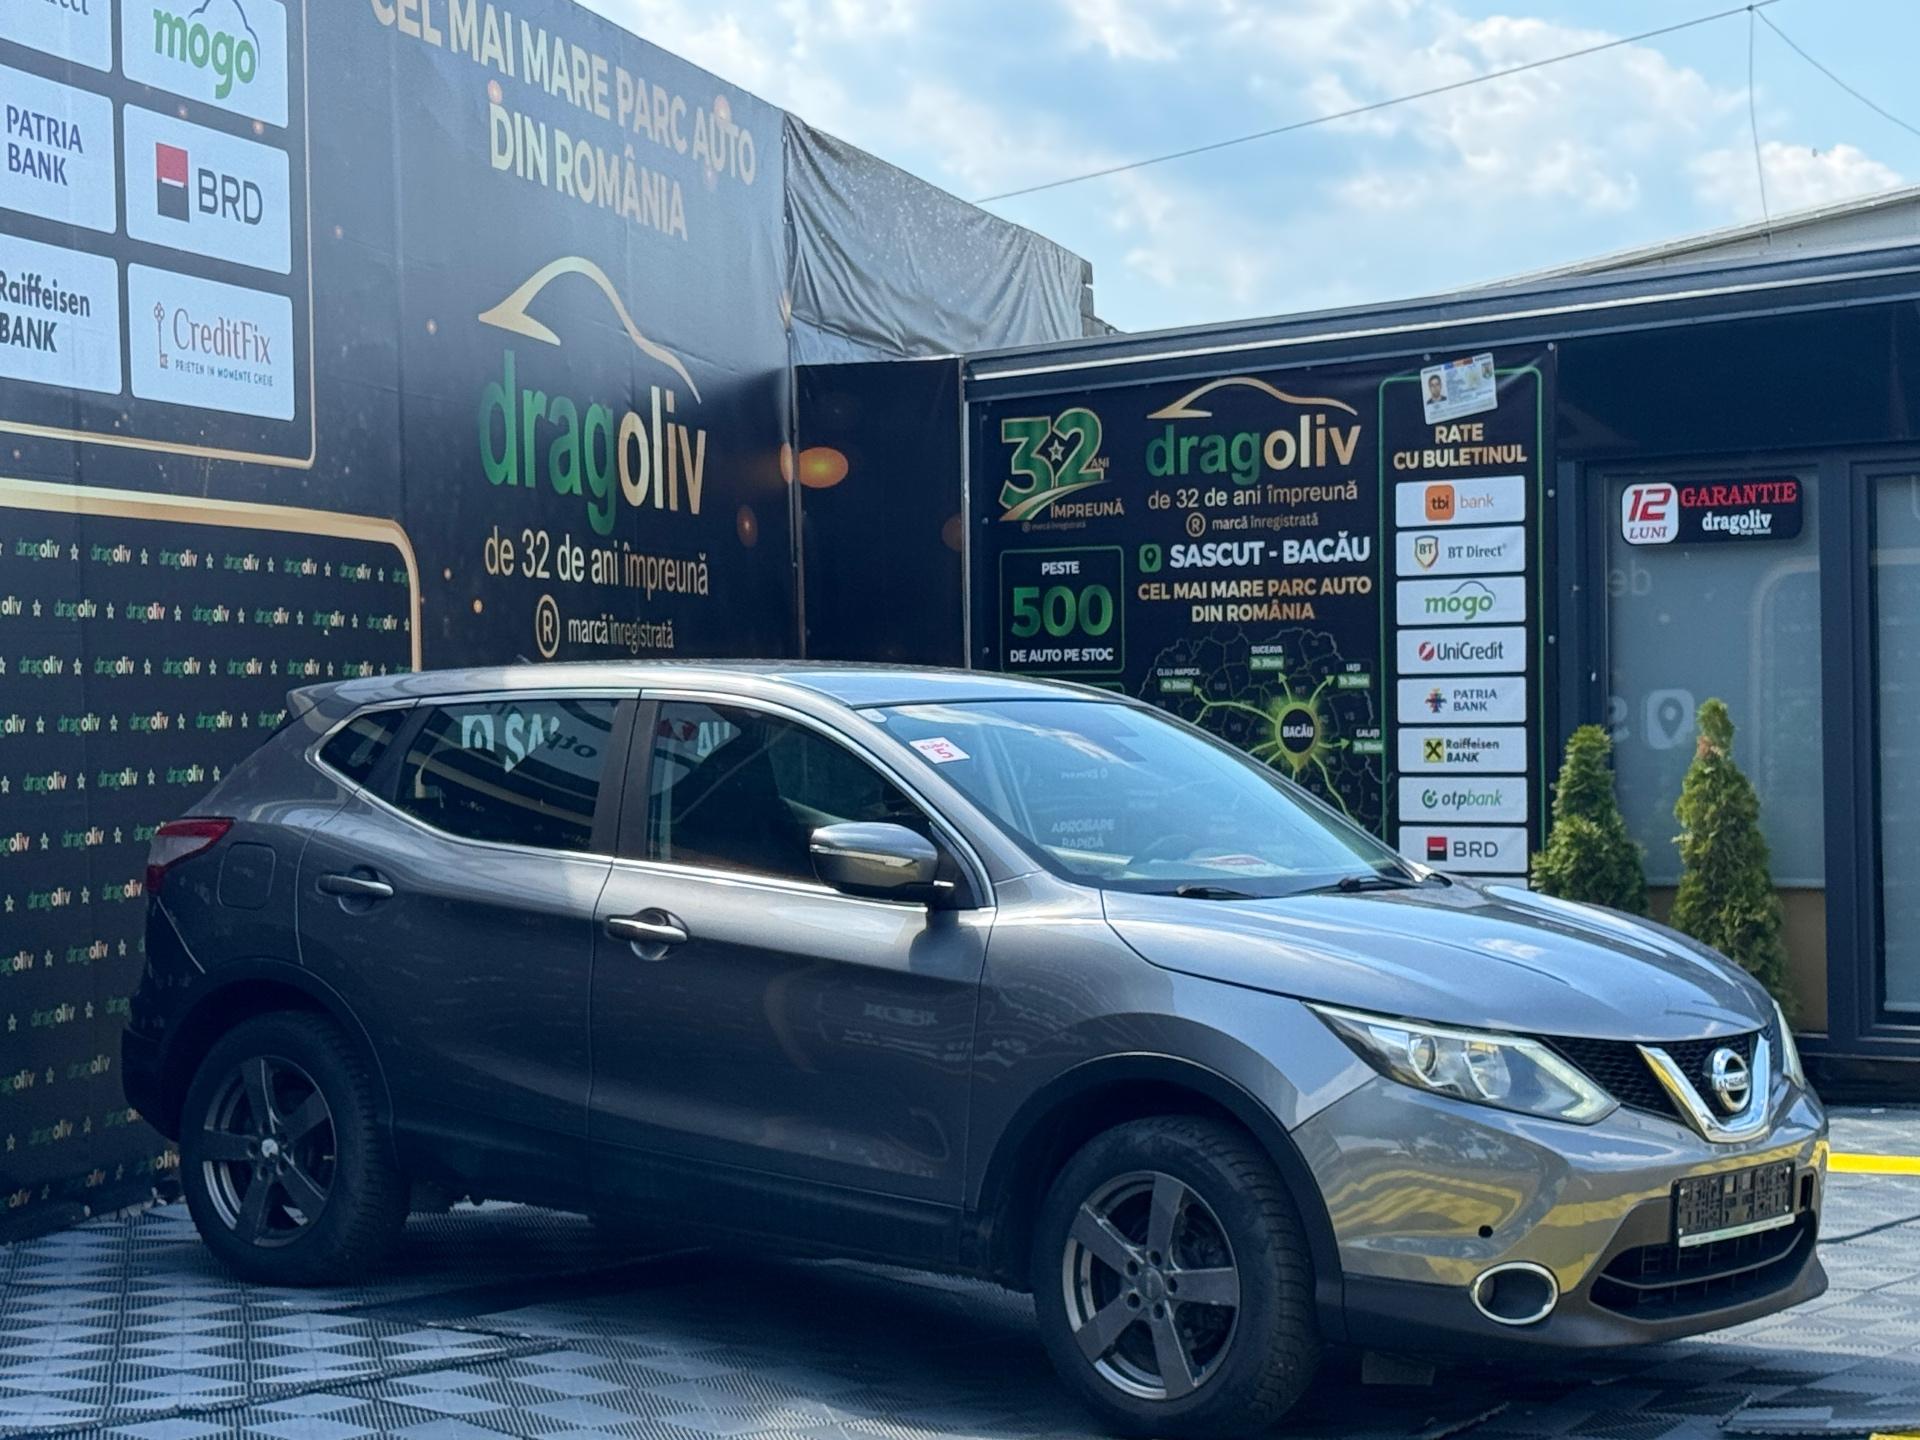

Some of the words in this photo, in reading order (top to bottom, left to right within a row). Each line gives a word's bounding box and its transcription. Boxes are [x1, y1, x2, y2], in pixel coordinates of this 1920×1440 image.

[153, 8, 256, 99] mogo
[449, 0, 515, 77] MAI
[520, 20, 610, 120] MARE
[616, 66, 688, 154] PARC
[693, 107, 756, 185] AUTO
[6, 104, 83, 154] PATRIA
[8, 142, 68, 186] BANK
[489, 103, 548, 186] DIN
[554, 129, 688, 241] ROMÂNIA
[198, 168, 263, 225] BRD
[0, 270, 90, 318] Raiffeisen
[0, 312, 57, 353] BANK
[173, 308, 271, 365] CreditFix
[175, 359, 204, 376] PRIETEN
[218, 368, 251, 383] MOMENTE
[479, 350, 706, 536] dragoliv
[1435, 423, 1484, 444] RATE
[1145, 414, 1361, 485] dragoliv
[1393, 452, 1419, 470] CU
[1423, 444, 1528, 468] BULETINUL
[1148, 490, 1170, 509] de
[1176, 488, 1199, 509] 32
[1204, 487, 1227, 507] de
[1233, 485, 1261, 506] ani
[1267, 480, 1358, 507] împreună
[1432, 495, 1449, 510] tbi
[1460, 494, 1494, 509] bank
[1628, 488, 1672, 523] 12
[1680, 482, 1797, 507] GARANTIE
[1050, 498, 1124, 518] ÎMPREUNĂ
[1212, 515, 1248, 531] marcă
[1250, 512, 1319, 532] înregistrată
[1629, 526, 1667, 540] LUNI
[1702, 508, 1772, 535] dragoliv
[16, 538, 60, 562] dragoliv
[91, 543, 131, 567] dragoliv
[159, 548, 198, 571] dragoliv
[224, 553, 260, 574] dragoliv
[1169, 540, 1265, 568] SASCUT
[1283, 530, 1371, 565] BACĂU
[1448, 546, 1464, 559] BT
[484, 525, 514, 576] de
[521, 528, 550, 579] 32
[557, 534, 584, 583] de
[591, 540, 619, 585] ani
[624, 542, 708, 601] împreună
[1042, 561, 1080, 576] PESTE
[1138, 583, 1171, 601] CEL
[1174, 582, 1207, 600] MAI
[1211, 580, 1264, 599] MARE
[1268, 578, 1317, 597] PARC
[1319, 576, 1371, 596] AUTO
[54, 599, 97, 622] dragoliv
[126, 601, 166, 624] dragoliv
[192, 604, 230, 626] dragoliv
[254, 606, 290, 628] dragoliv
[1011, 584, 1113, 637] 500
[1192, 604, 1223, 622] DIN
[1227, 599, 1315, 622] ROMÂNIA
[1425, 595, 1493, 620] mogo
[568, 613, 609, 645] marcă
[1010, 649, 1027, 663] DE
[1028, 649, 1062, 663] AUTO
[1064, 648, 1081, 662] PE
[1082, 647, 1114, 661] STOC
[1437, 641, 1503, 660] UniCredit
[19, 656, 63, 679] dragoliv
[94, 656, 134, 679] dragoliv
[162, 656, 201, 679] dragoliv
[227, 657, 262, 679] dragoliv
[1453, 688, 1498, 700] PATRIA
[1453, 701, 1488, 712] BANK
[58, 713, 100, 737] dragoliv
[129, 711, 169, 736] dragoliv
[196, 710, 233, 733] dragoliv
[1283, 724, 1314, 738] BACĂU
[1446, 738, 1500, 750] Raiffeisen
[1447, 752, 1479, 763] BANK
[23, 771, 67, 795] dragoliv
[98, 768, 138, 790] dragoliv
[166, 764, 204, 787] dragoliv
[1441, 788, 1502, 810] otpbank
[62, 826, 104, 850] dragoliv
[1453, 841, 1499, 858] BRD
[27, 887, 71, 911] dragoliv
[103, 879, 143, 903] dragoliv
[66, 940, 108, 966] dragoliv
